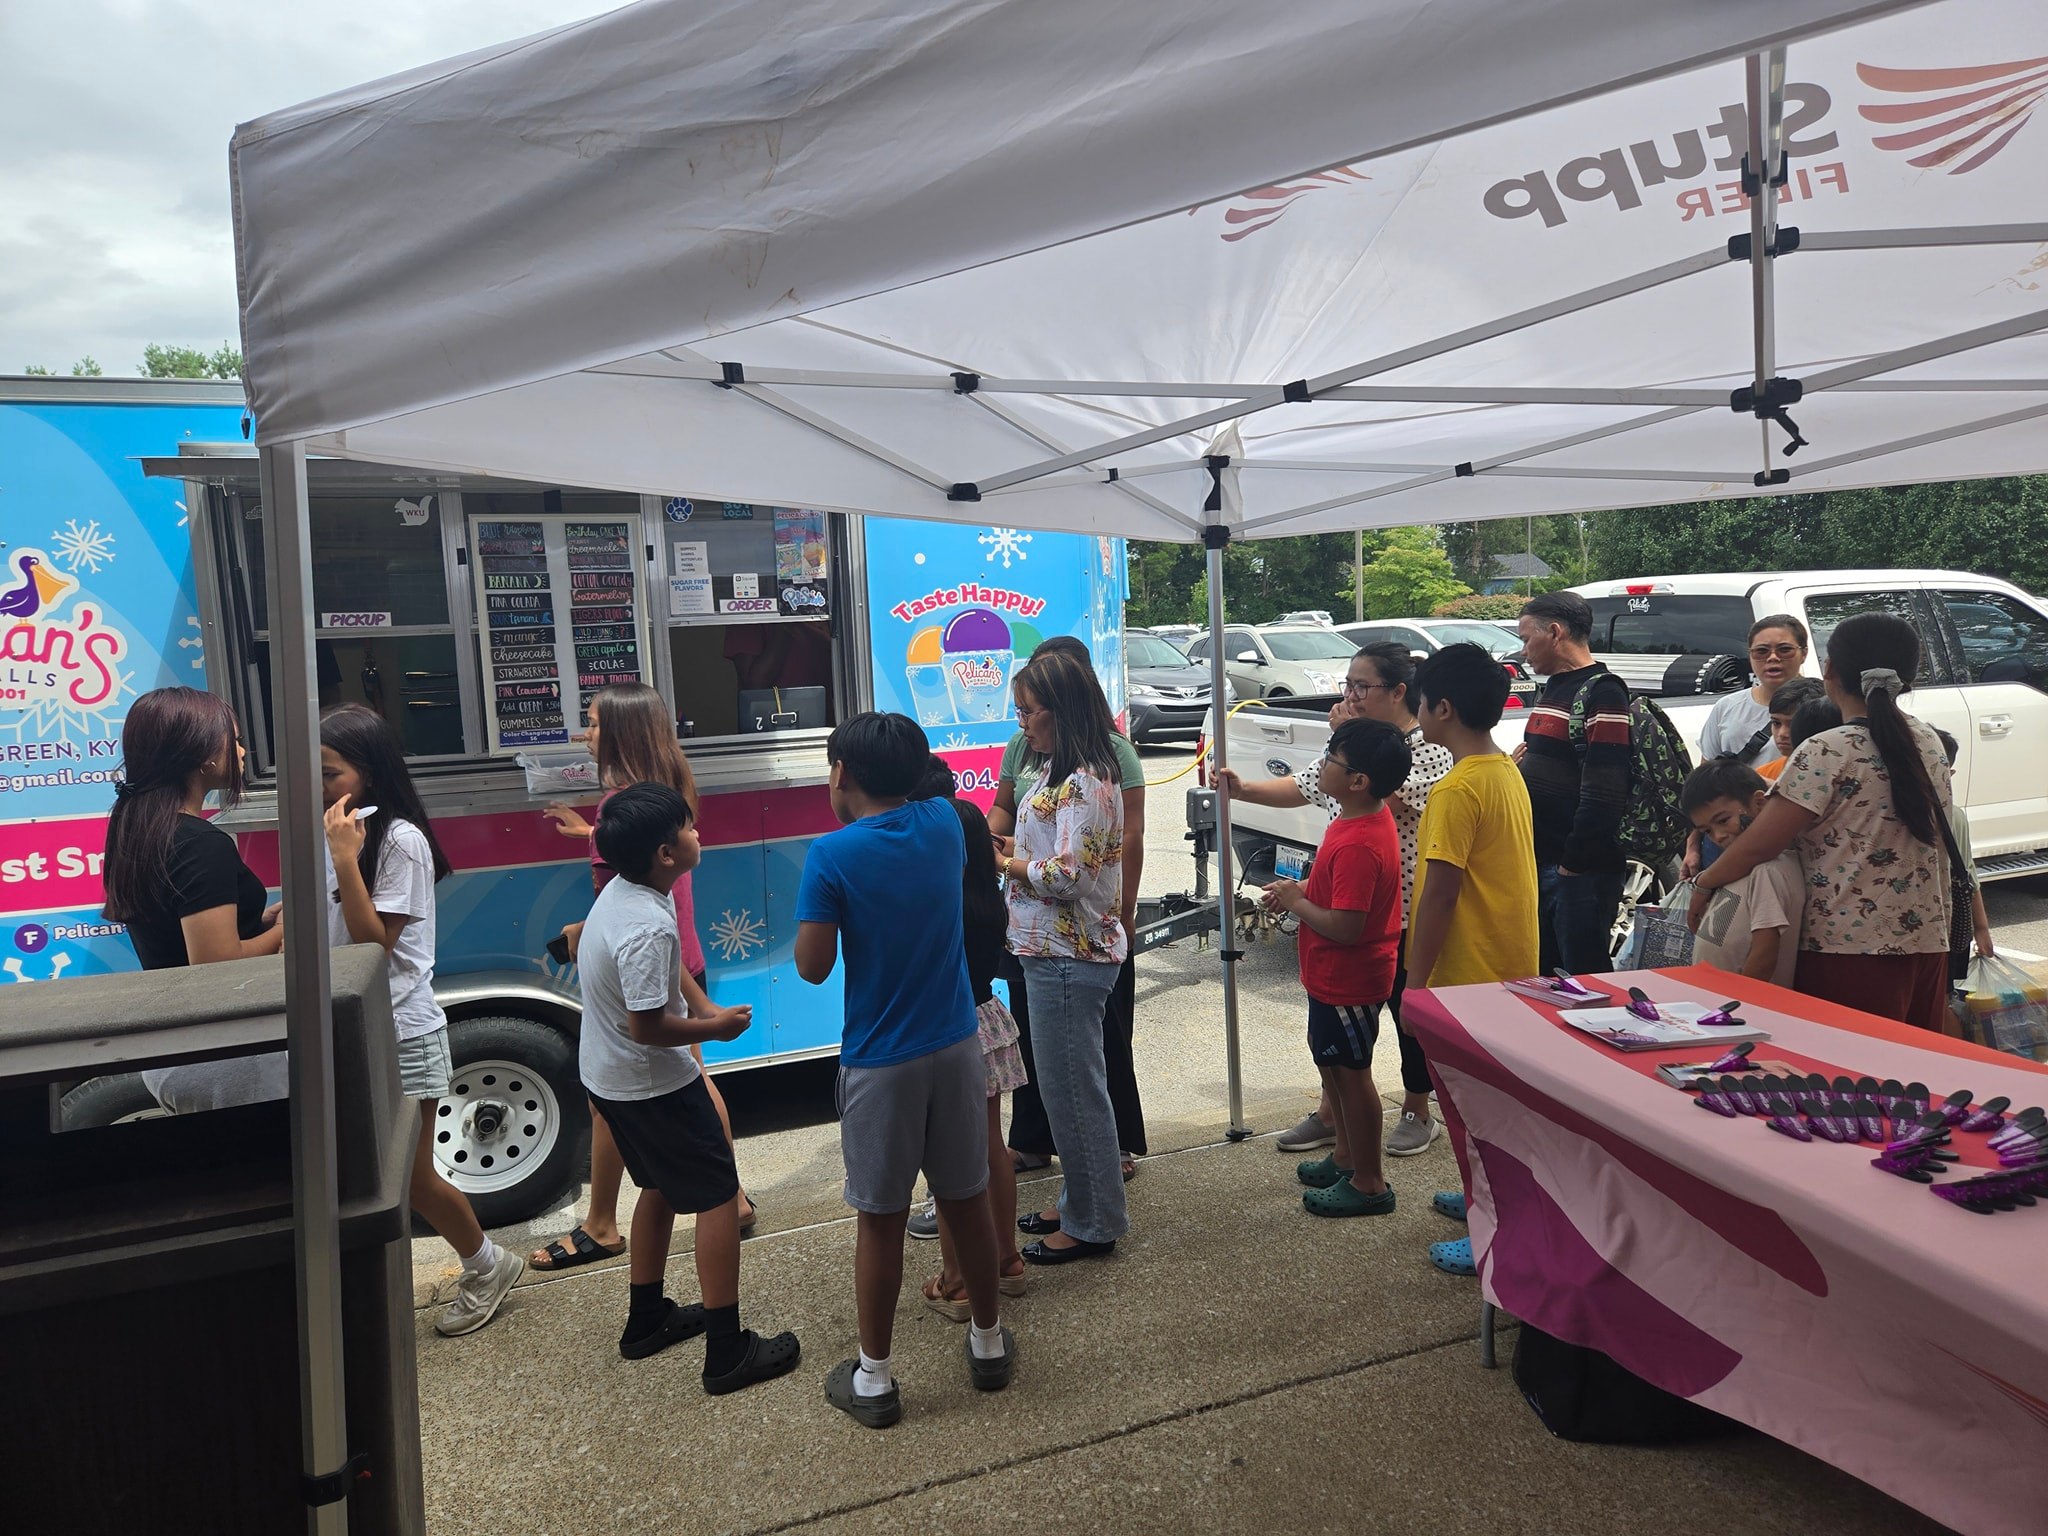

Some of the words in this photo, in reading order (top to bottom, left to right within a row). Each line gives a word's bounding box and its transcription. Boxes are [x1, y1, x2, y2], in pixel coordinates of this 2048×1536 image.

[405, 509, 425, 517] WKU
[723, 509, 753, 518] LOCAL
[568, 541, 620, 555] dreamsicle
[487, 575, 531, 589] BANANA
[572, 573, 600, 588] COTTON
[601, 572, 633, 588] candy
[510, 596, 541, 608] COLADA
[571, 588, 632, 602] watermelon
[726, 600, 773, 612] ORDER
[892, 588, 959, 622] Taste
[959, 584, 1045, 616] Happy!
[329, 613, 387, 627] PICKUP
[574, 608, 603, 621] TIGERS
[503, 631, 541, 645] mango
[575, 627, 592, 637] WILD
[493, 646, 553, 661] cheesecake
[577, 645, 600, 658] GREEN
[600, 642, 625, 657] apple
[499, 665, 549, 679] STRAWBERRY
[593, 659, 620, 671] COLA
[580, 674, 606, 686] BAHAMA
[952, 660, 1002, 688] Pelican's
[498, 686, 514, 698] PINK
[501, 701, 516, 713] Add
[518, 700, 544, 713] CREAM
[500, 716, 542, 730] GUMMIES
[520, 730, 550, 738] Changing
[88, 739, 119, 758] KY
[561, 767, 593, 784] Pelican's
